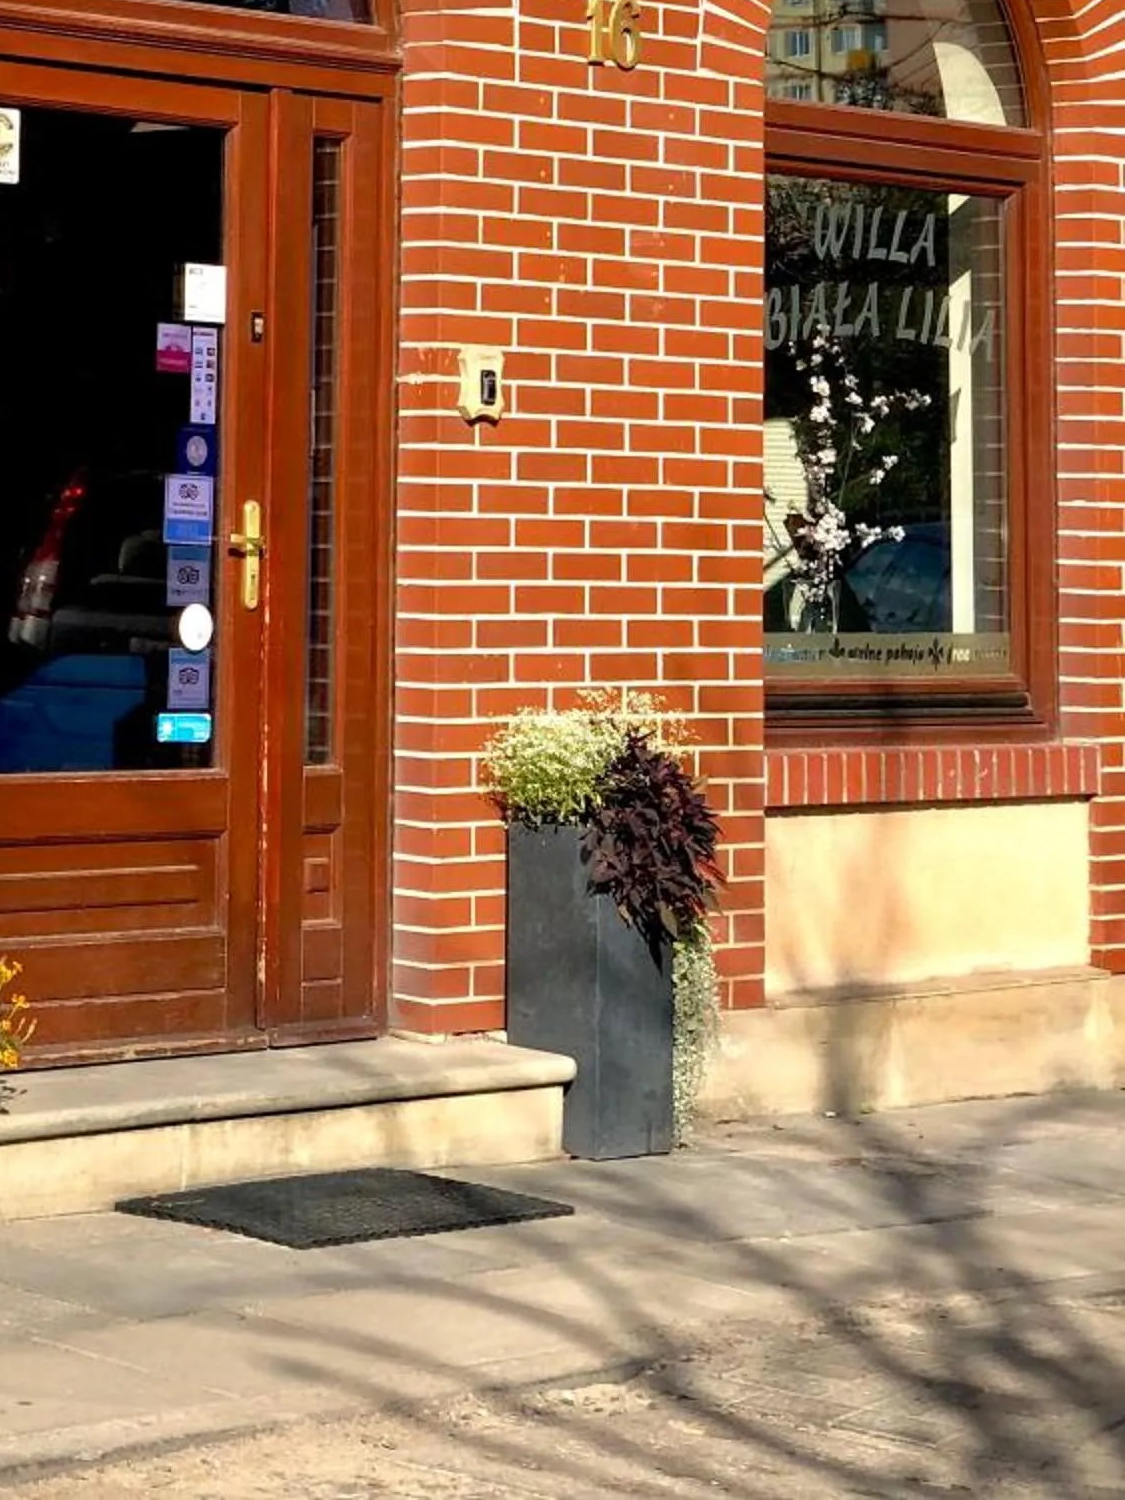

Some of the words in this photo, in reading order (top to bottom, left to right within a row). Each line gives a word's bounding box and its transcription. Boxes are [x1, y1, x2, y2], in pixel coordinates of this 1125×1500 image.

[813, 202, 937, 268] WILLA
[764, 281, 881, 350] BIAŁA
[895, 285, 995, 363] LILIA
